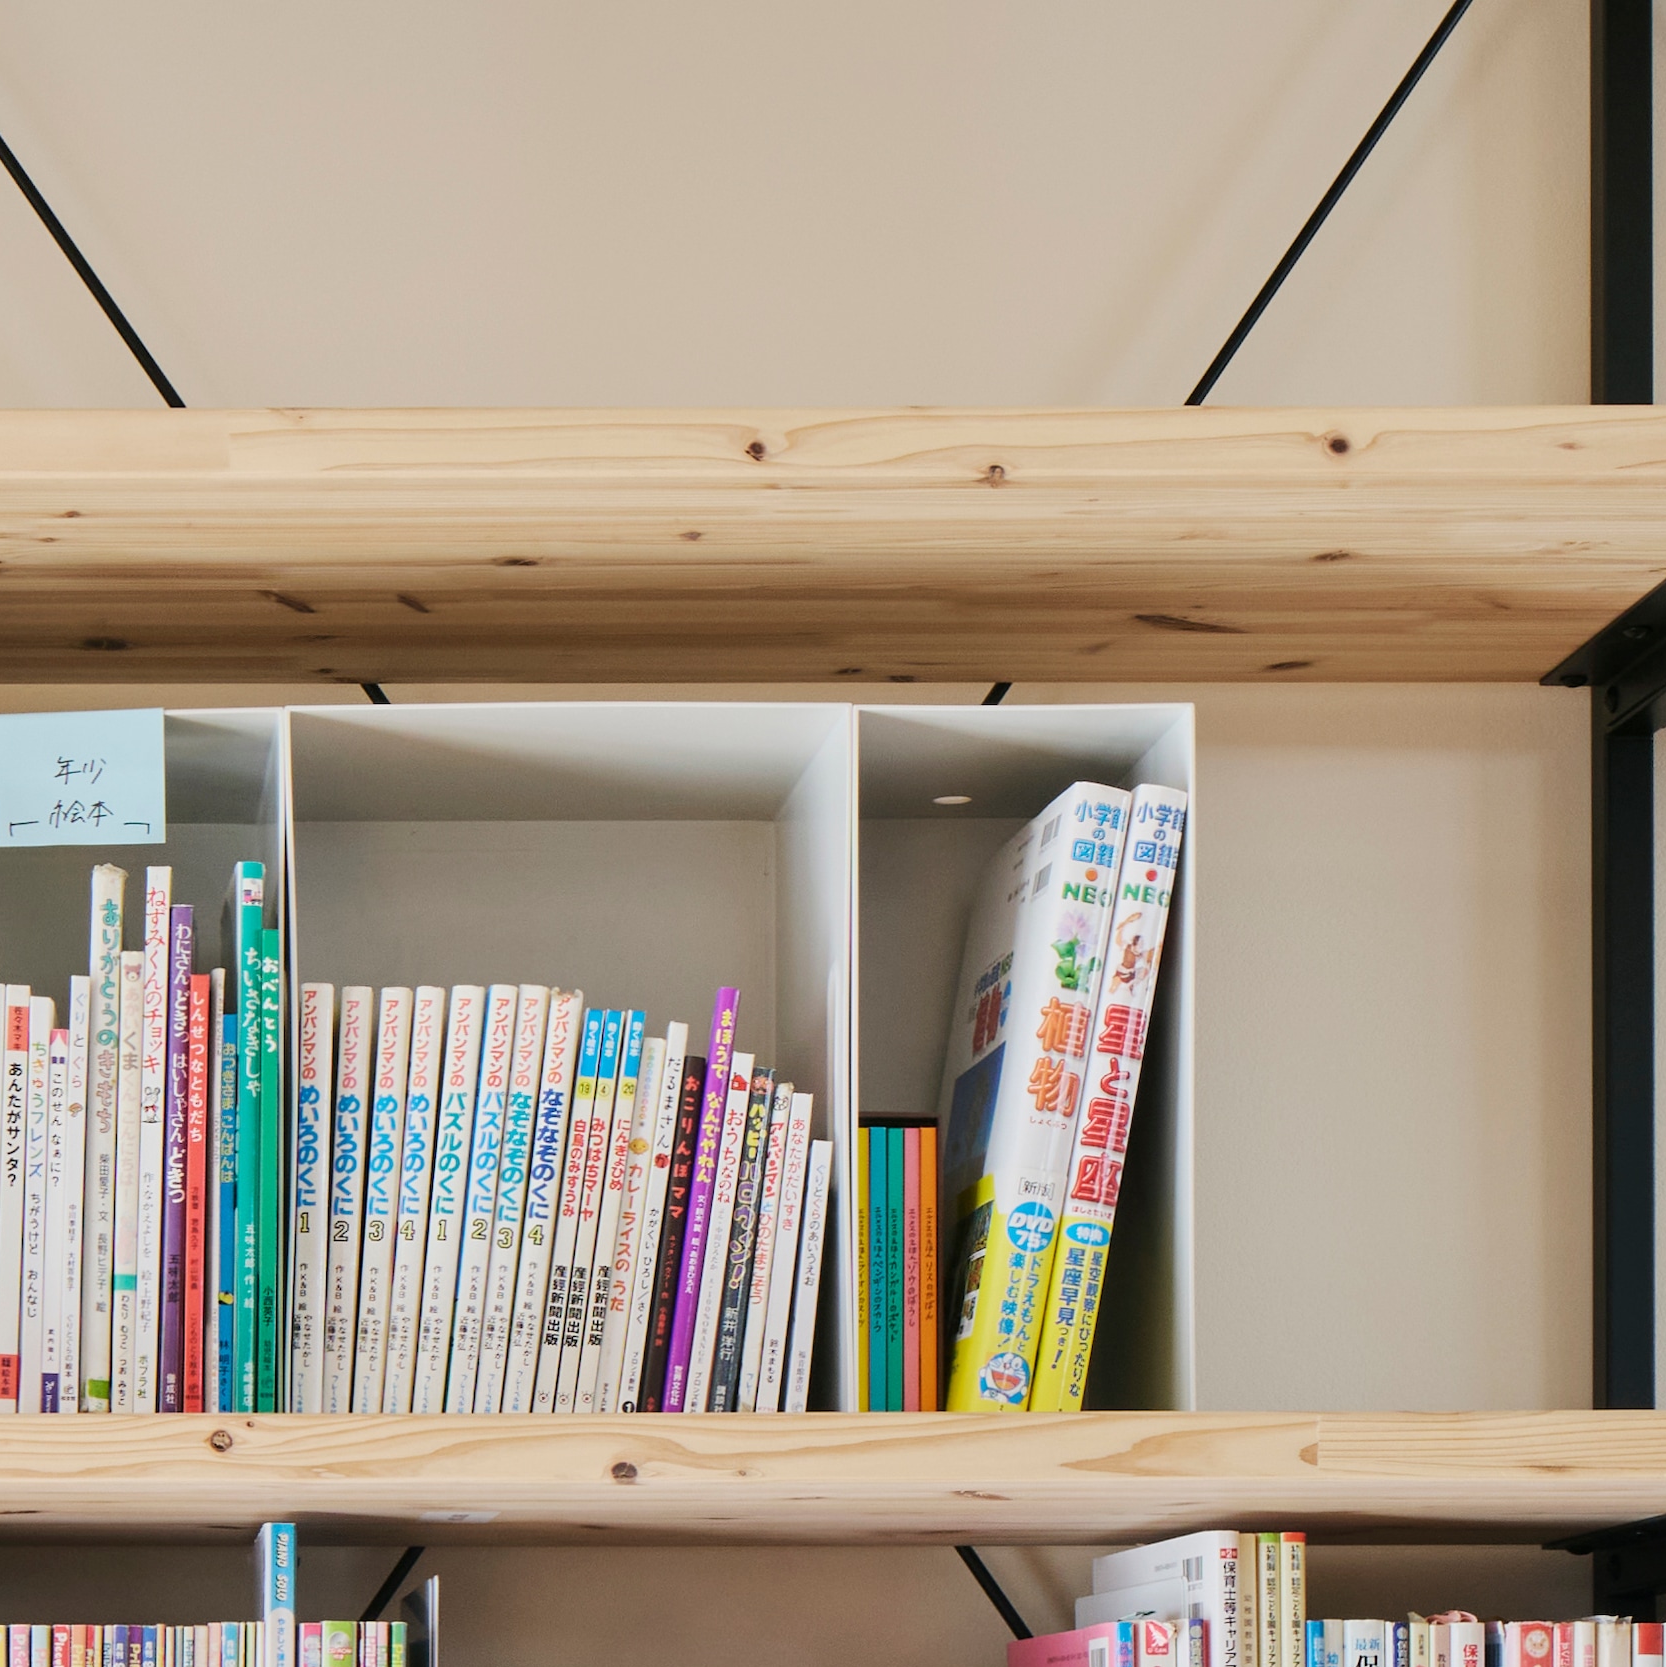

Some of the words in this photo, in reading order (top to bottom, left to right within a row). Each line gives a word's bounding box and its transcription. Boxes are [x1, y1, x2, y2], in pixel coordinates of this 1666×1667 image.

[1075, 800, 1126, 832] 小学館
[1137, 801, 1185, 833] 小学館
[1062, 882, 1112, 908] NEO
[1122, 883, 1171, 908] NEO
[144, 887, 166, 1075] ねずみくんのチョッキ
[261, 956, 278, 1053] おべんとう
[188, 991, 206, 1142] しんせつなともだち
[302, 991, 317, 1081] アンパンマンの
[342, 1000, 360, 1089] アンパンマンの
[379, 1000, 399, 1090] アンパンマンの
[412, 1000, 433, 1088] アンパンマンの
[450, 998, 472, 1088] アンパンマンの
[487, 998, 510, 1088] アンパンマンの
[515, 998, 538, 1088] アンパンマンの
[547, 995, 570, 1085] アンパンマンの
[1027, 997, 1091, 1117] 植物
[6, 1062, 24, 1187] あんたがサンタ?
[297, 1084, 320, 1207] めいろのくに
[669, 1075, 701, 1218] おこりんぼママ
[1070, 1003, 1146, 1207] 星と星座
[334, 1092, 361, 1216] めいろのくに
[368, 1092, 398, 1216] めいろのくに
[400, 1092, 430, 1216] めいろのくに
[435, 1091, 468, 1215] パズルのくに
[473, 1090, 506, 1214] パズルのくに
[498, 1091, 533, 1223] なぞなぞのくに
[529, 1088, 565, 1221] なぞなぞのくに
[562, 1119, 587, 1217] 白鳥のみずうみ
[609, 1119, 632, 1190] にんぎょひめ
[782, 1117, 805, 1231] あなたがだいすき
[300, 1212, 310, 1233] 1
[333, 1220, 349, 1242] 2
[369, 1220, 384, 1242] 3
[400, 1220, 416, 1241] 4
[437, 1220, 447, 1241] 1
[471, 1219, 488, 1240] 2
[497, 1228, 513, 1249] 3
[528, 1225, 544, 1246] 4
[1010, 1213, 1055, 1232] DVD
